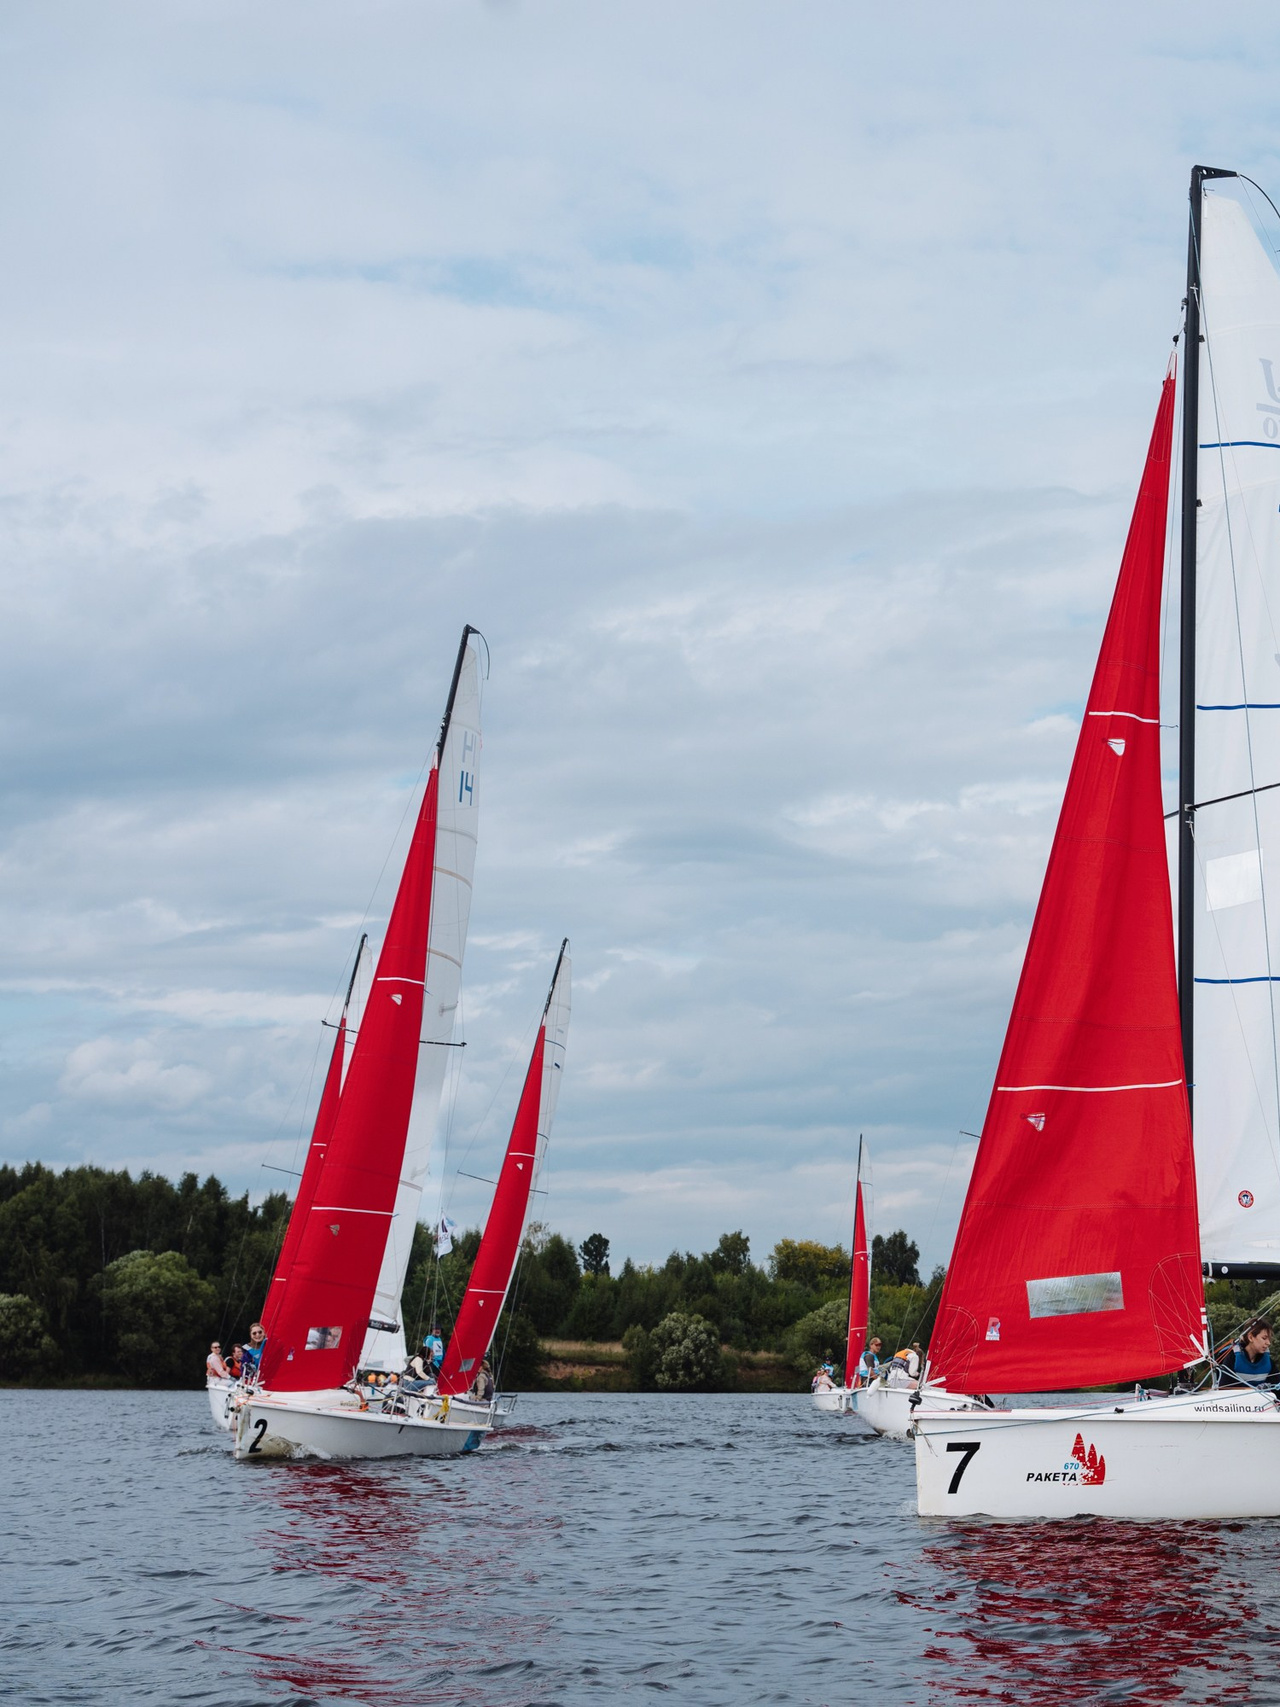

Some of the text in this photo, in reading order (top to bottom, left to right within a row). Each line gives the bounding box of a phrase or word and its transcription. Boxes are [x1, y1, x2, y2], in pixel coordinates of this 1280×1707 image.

[459, 770, 474, 807] 14
[248, 1418, 268, 1454] 2
[946, 1441, 981, 1495] 7
